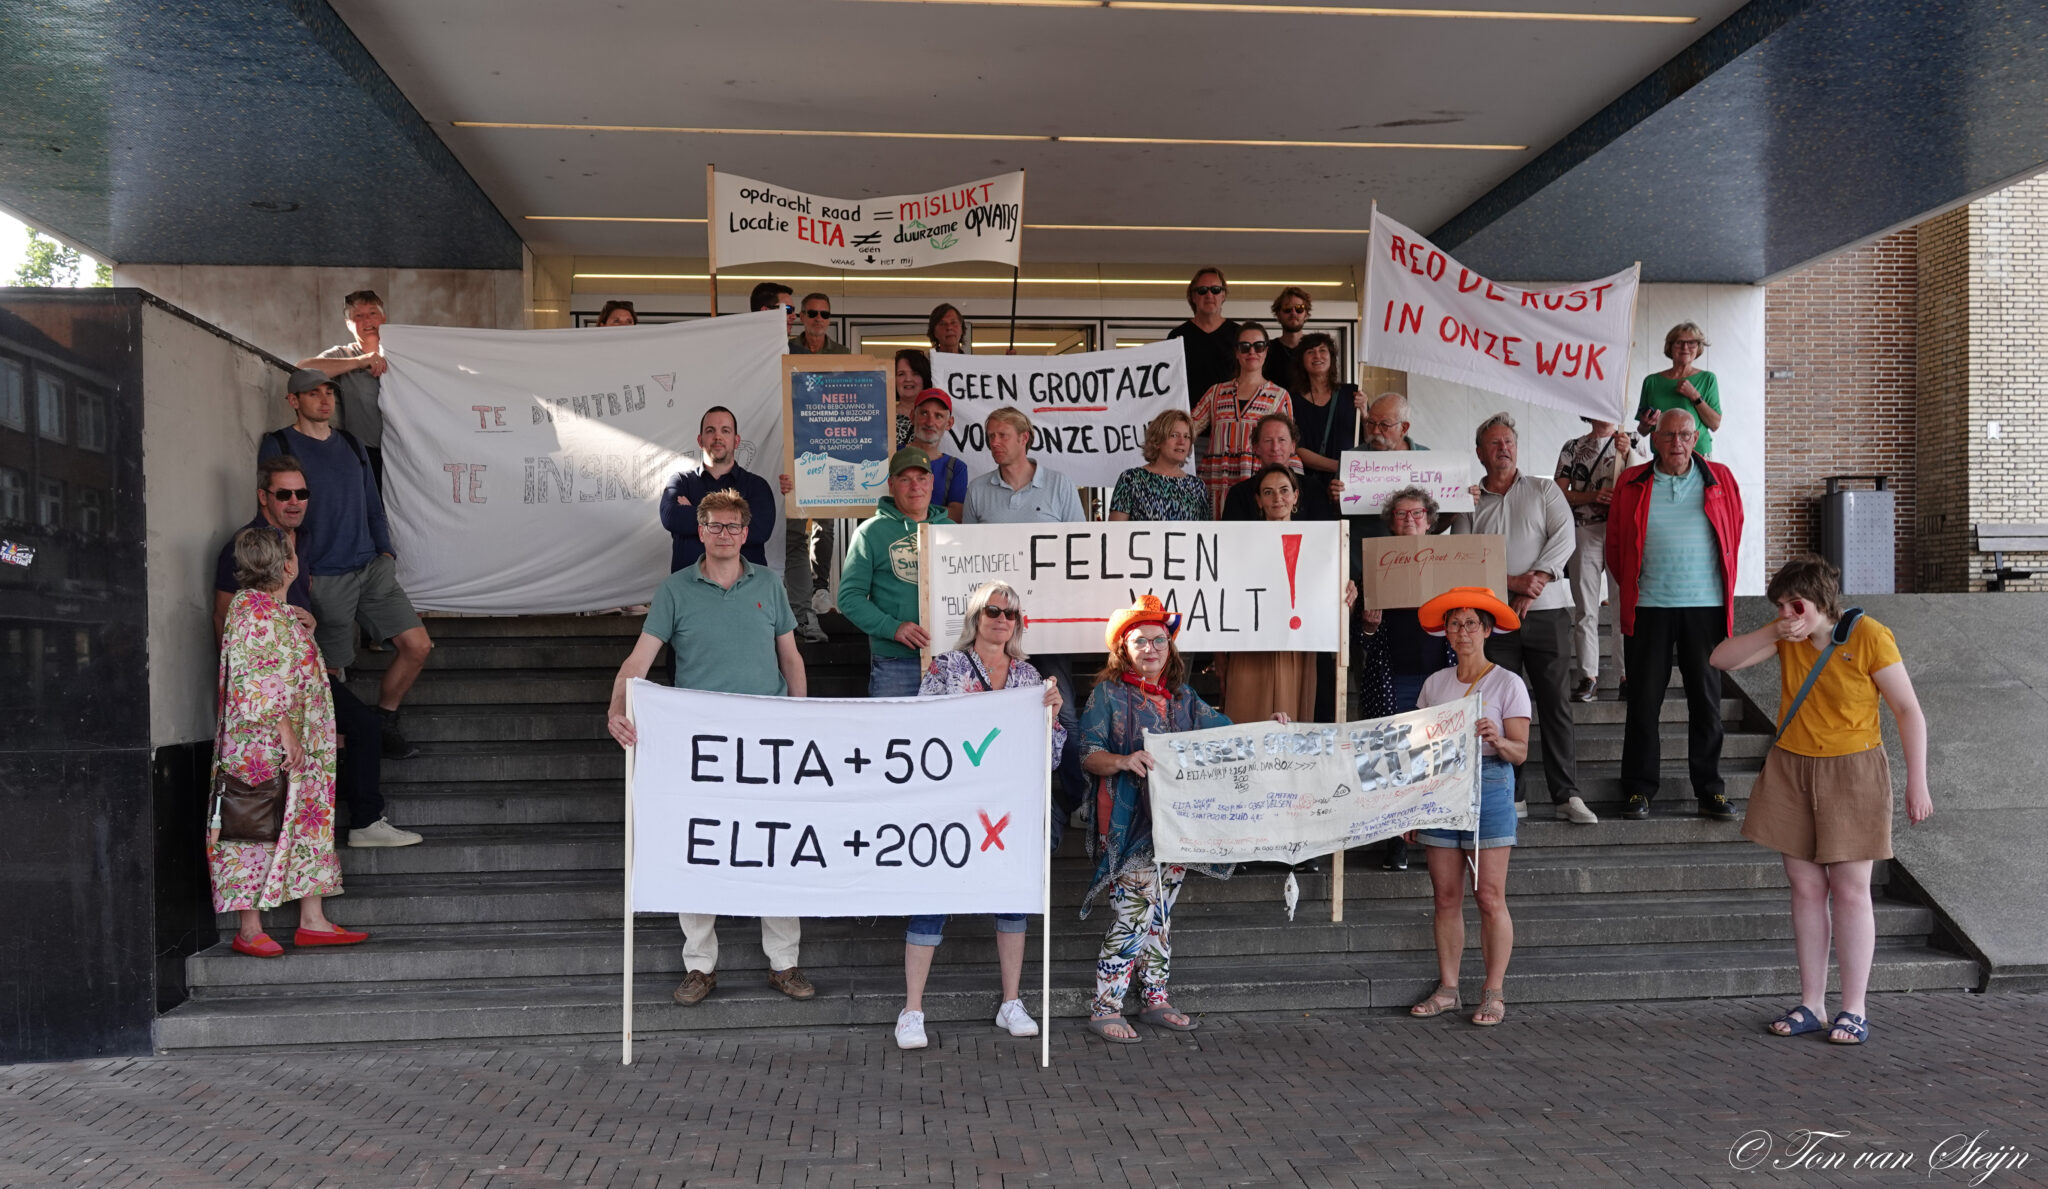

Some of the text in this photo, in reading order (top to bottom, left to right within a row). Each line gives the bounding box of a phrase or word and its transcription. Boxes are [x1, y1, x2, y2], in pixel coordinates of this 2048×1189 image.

[740, 188, 812, 214] opdracht
[729, 212, 789, 233] Locatie
[798, 216, 845, 248] ELTA
[894, 221, 958, 244] duurzame
[1391, 235, 1447, 282] RED
[1384, 300, 1424, 334] IN
[1439, 316, 1523, 367] ONZE
[822, 394, 857, 403] NEE!!!
[948, 362, 1170, 405] GEEN GROOT AZC
[472, 405, 507, 430] TE
[824, 427, 857, 437] GEEN
[949, 423, 990, 453] VO
[1104, 421, 1154, 454] DEU
[800, 452, 828, 466] Steun
[1410, 471, 1442, 483] ELTA
[443, 463, 488, 504] TE
[1030, 531, 1218, 582] FELSEN
[691, 734, 833, 787] ELTA
[884, 738, 953, 784] 50
[687, 817, 827, 868] ELTA
